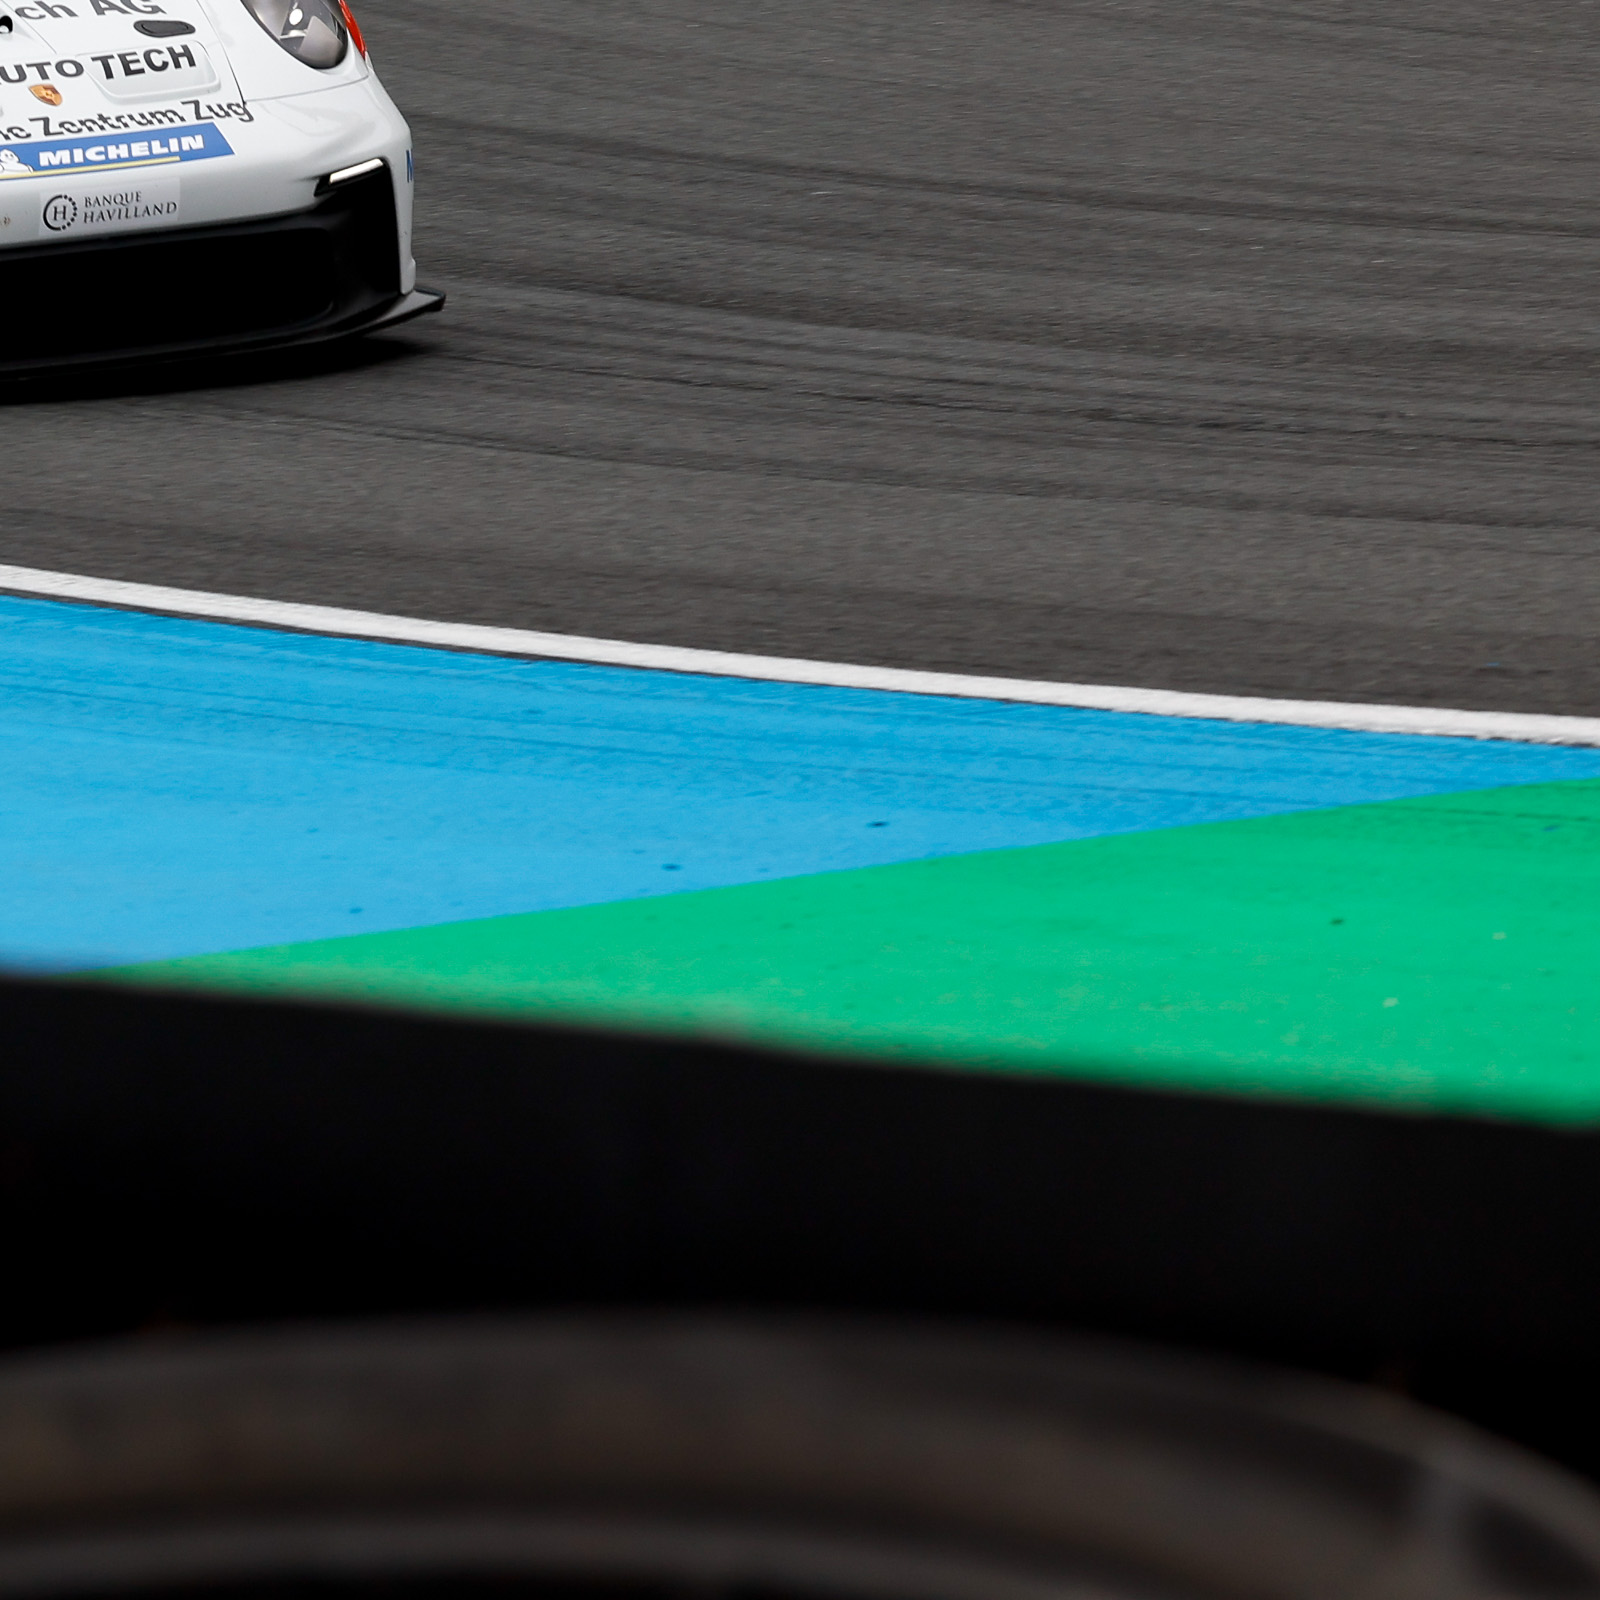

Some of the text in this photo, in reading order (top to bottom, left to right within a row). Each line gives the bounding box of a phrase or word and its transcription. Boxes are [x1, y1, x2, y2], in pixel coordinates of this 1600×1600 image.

[90, 43, 197, 80] TECH
[182, 99, 255, 123] Zug
[38, 133, 206, 168] MICHELIN
[84, 190, 142, 208] BANQUE
[52, 205, 68, 221] H
[83, 201, 178, 224] HAVILLAND
